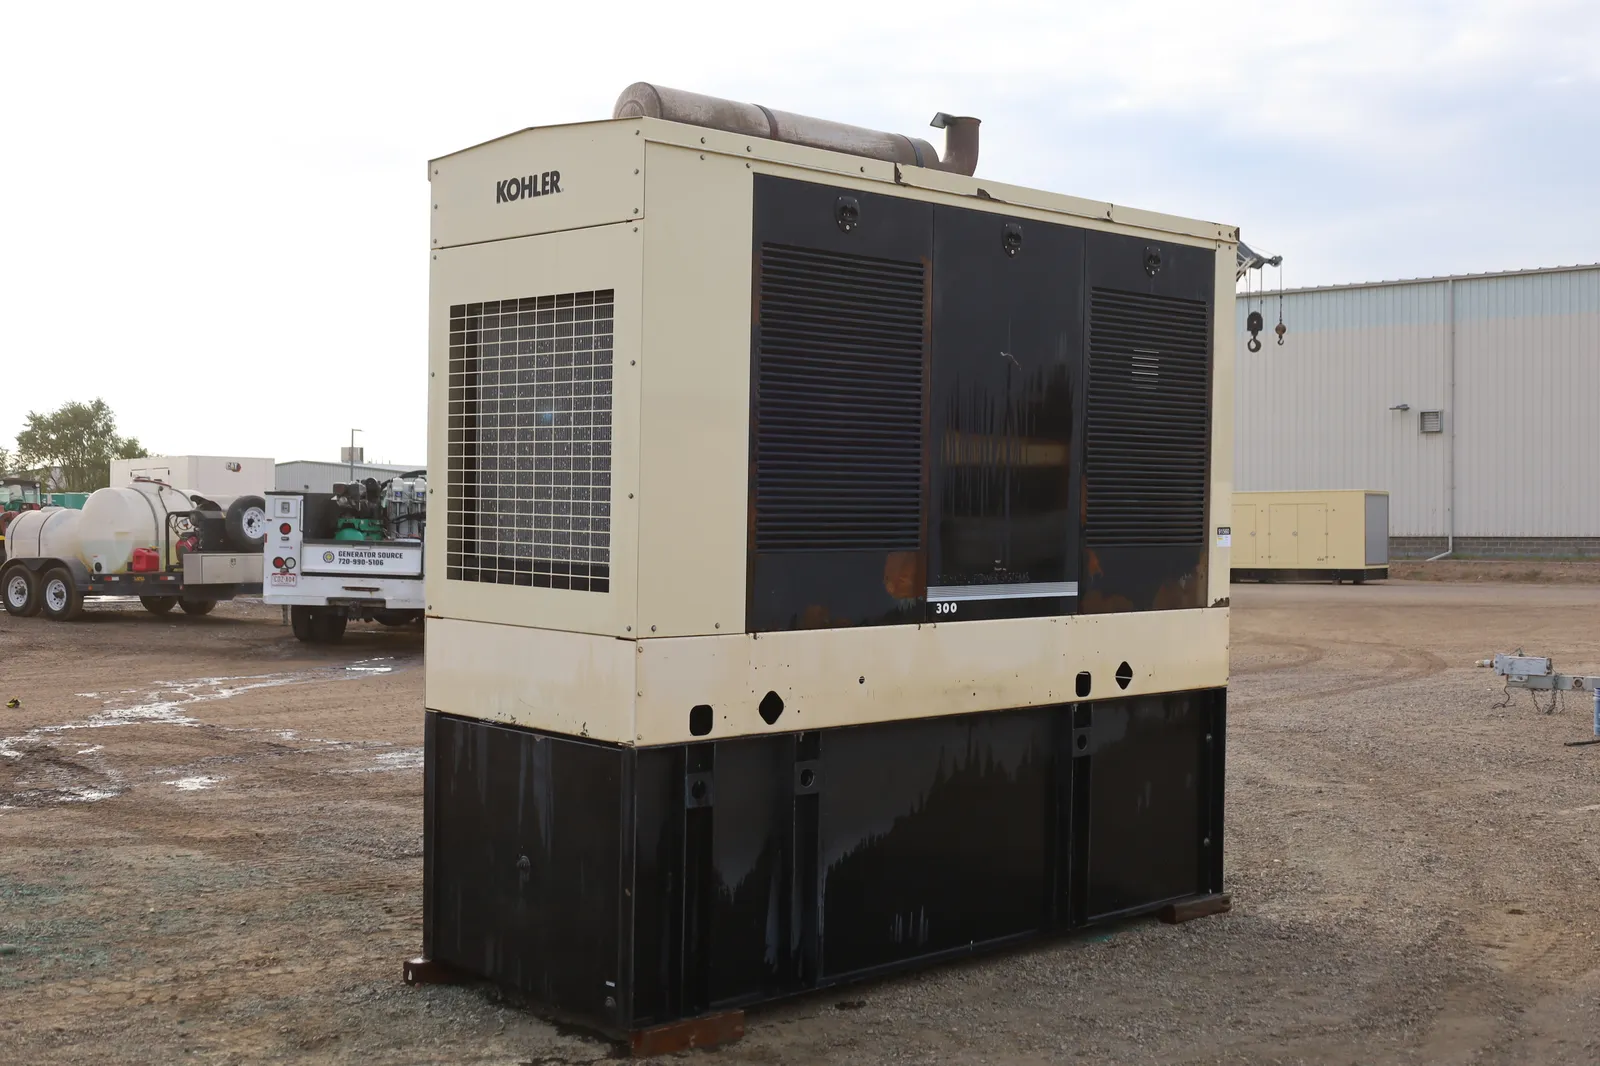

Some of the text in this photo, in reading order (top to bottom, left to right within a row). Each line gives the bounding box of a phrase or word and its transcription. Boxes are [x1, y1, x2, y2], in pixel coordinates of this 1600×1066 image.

[496, 170, 561, 204] KOHLER
[338, 550, 403, 560] GENERATOR SOURCE
[338, 558, 384, 566] 720-990-5106
[936, 602, 957, 614] 300
